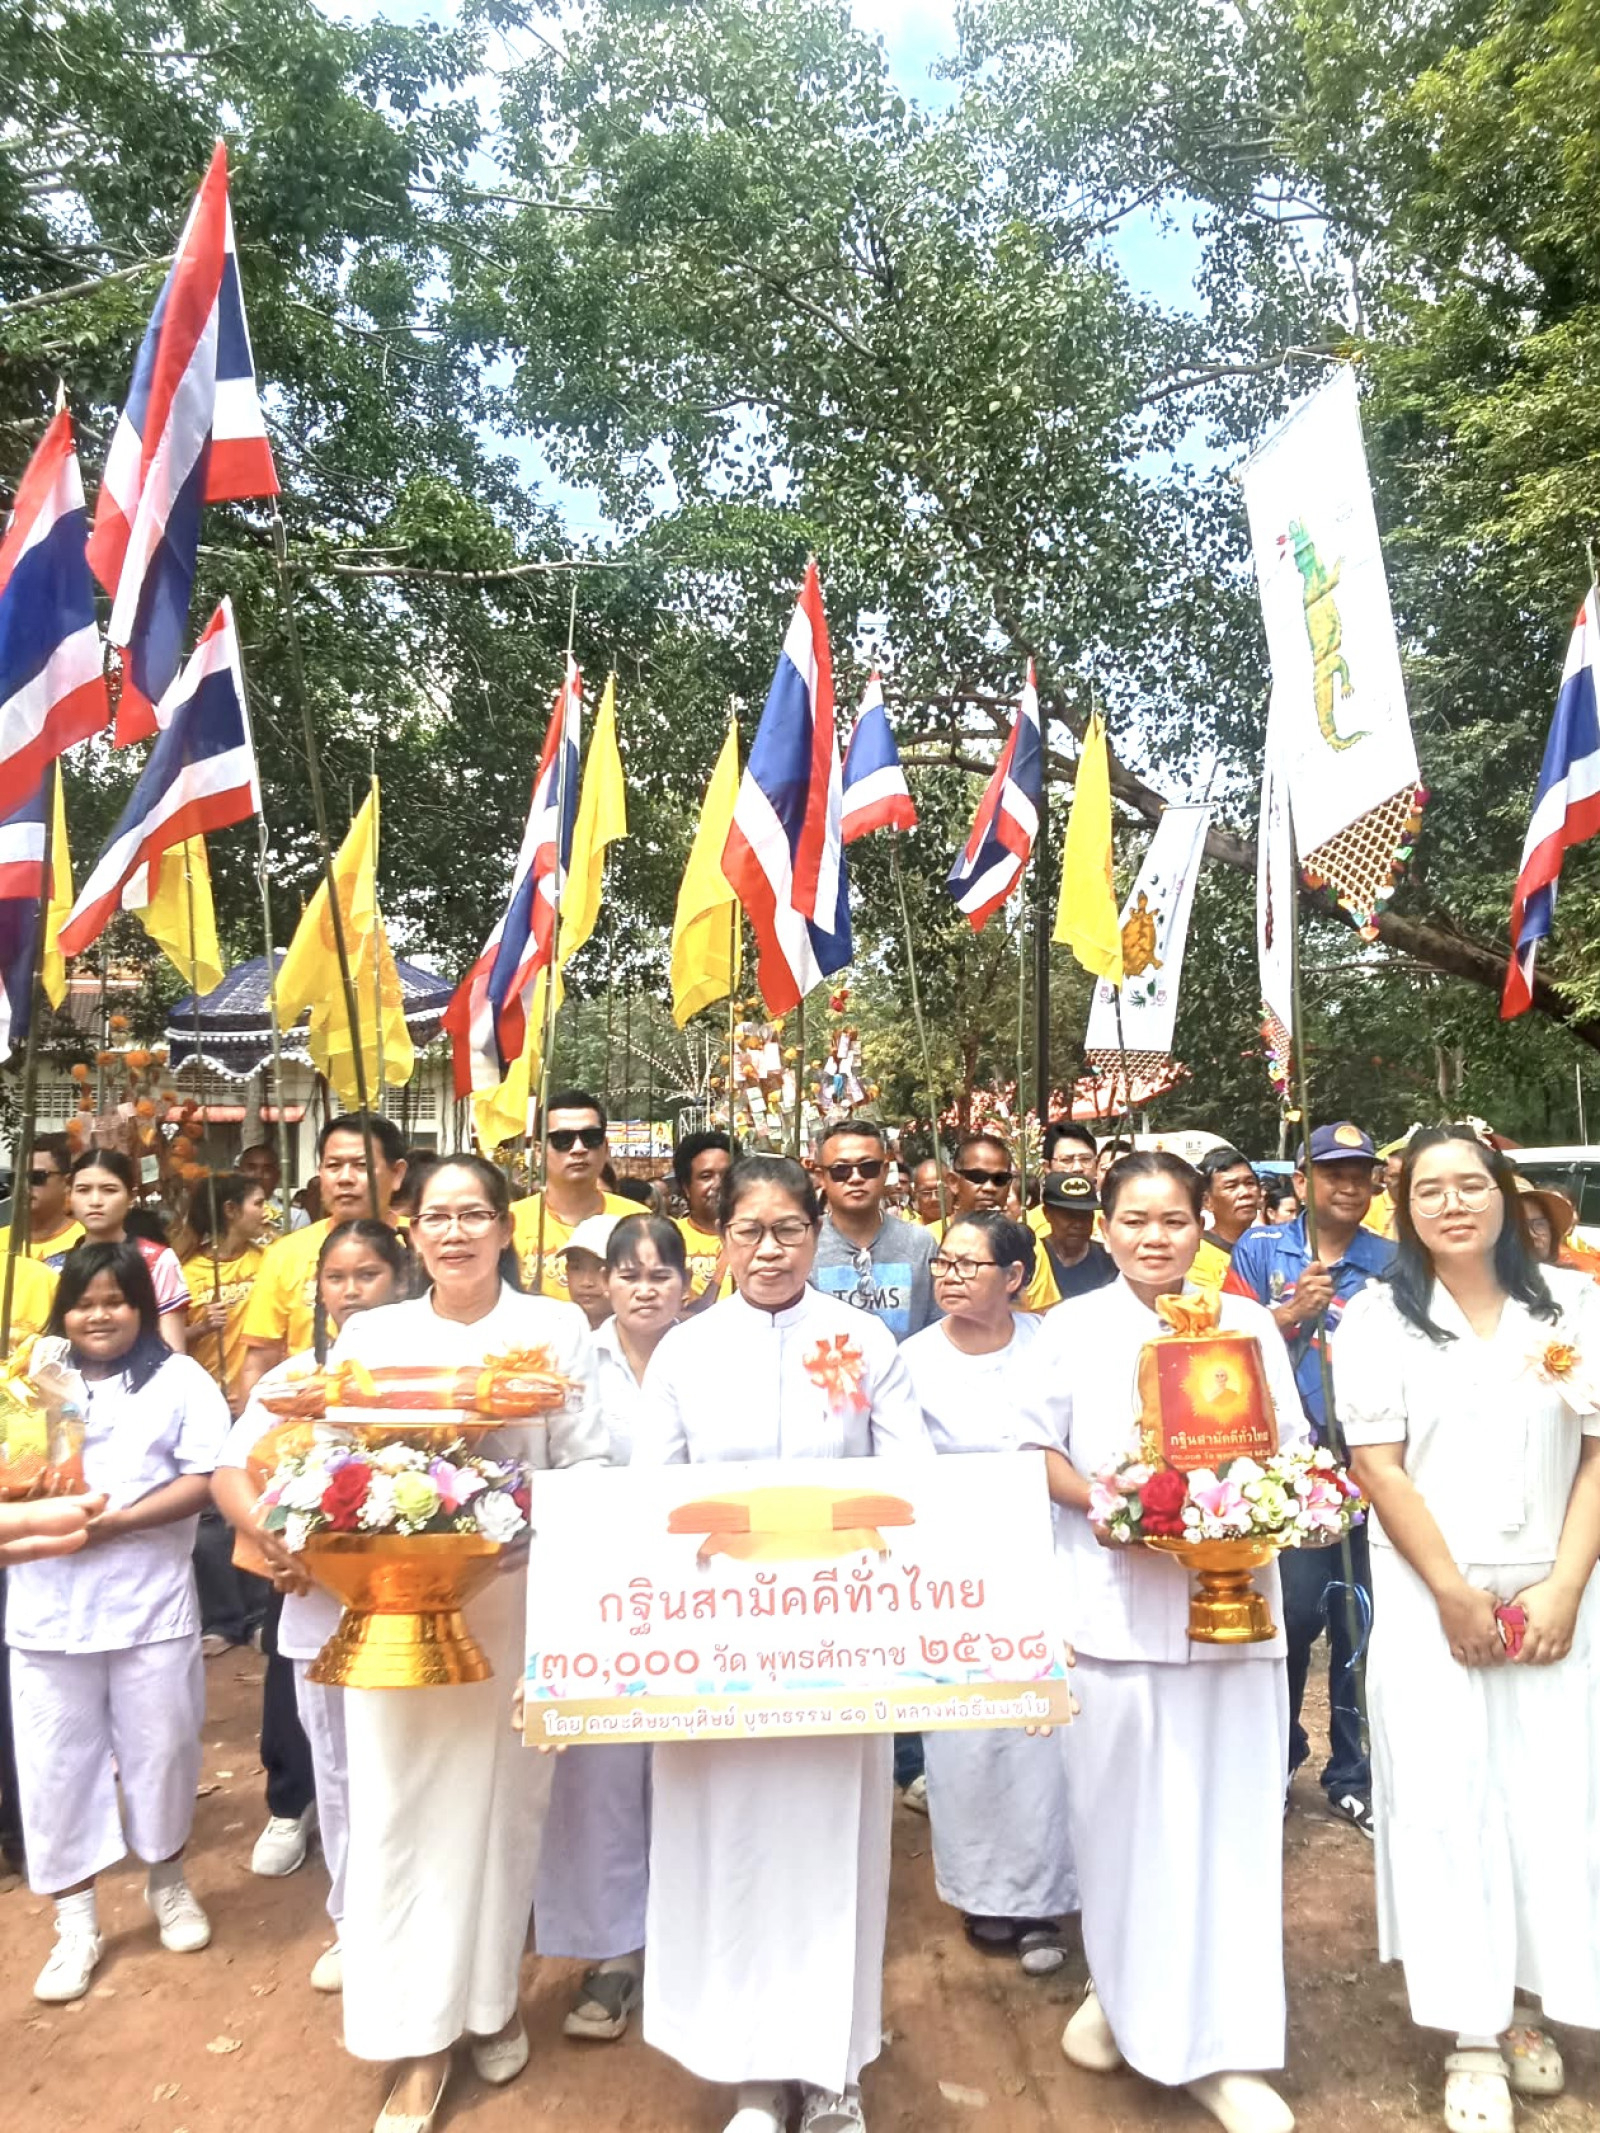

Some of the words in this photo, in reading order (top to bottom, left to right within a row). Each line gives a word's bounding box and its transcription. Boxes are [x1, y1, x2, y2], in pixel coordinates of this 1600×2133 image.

[833, 1287, 899, 1309] TOMS
[600, 1555, 984, 1636] กฐินสามัคคีทั่วไทย
[713, 1643, 747, 1673] วัด
[757, 1639, 905, 1681] พุทธศักราช
[919, 1630, 1047, 1665] ๒๕๖๘
[546, 1710, 580, 1732] โดย
[873, 1700, 888, 1721] ปี
